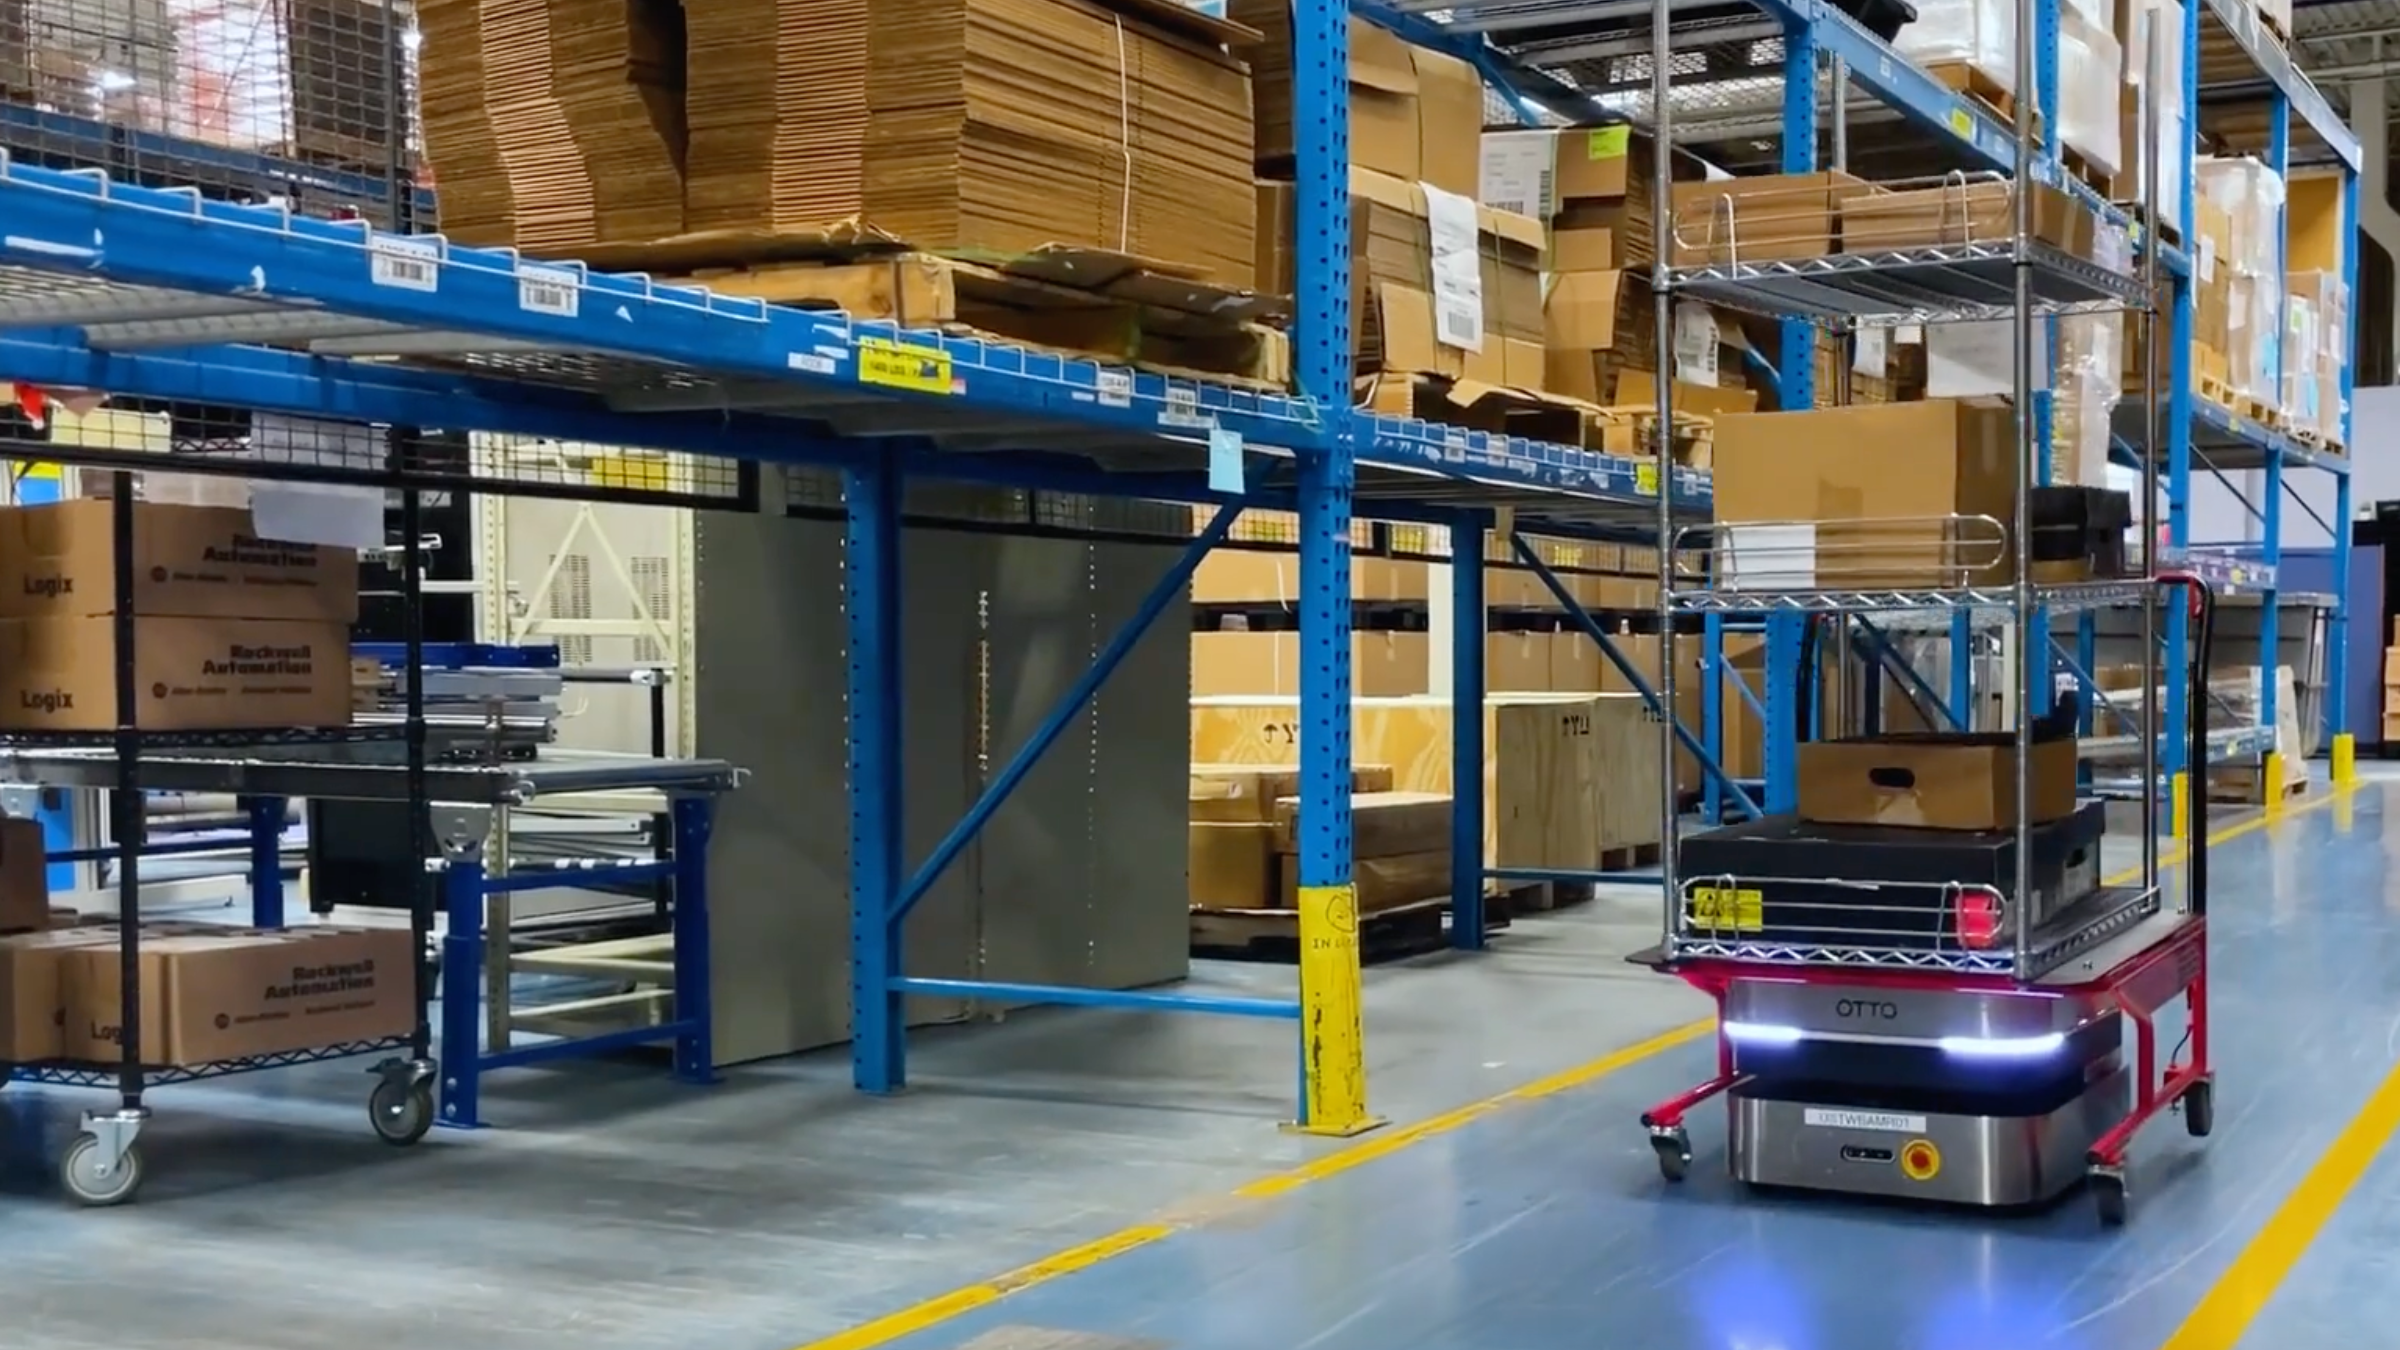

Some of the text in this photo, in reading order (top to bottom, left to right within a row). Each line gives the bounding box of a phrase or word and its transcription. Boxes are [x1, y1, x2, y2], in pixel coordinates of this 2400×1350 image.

[23, 573, 74, 599] Logix
[230, 645, 312, 660] Rockwell
[202, 659, 312, 675] Automation
[21, 689, 74, 713] Logix
[292, 959, 375, 980] Rockwell
[264, 977, 375, 1001] Automation
[1836, 998, 1898, 1020] OTTO
[91, 1020, 123, 1045] Log
